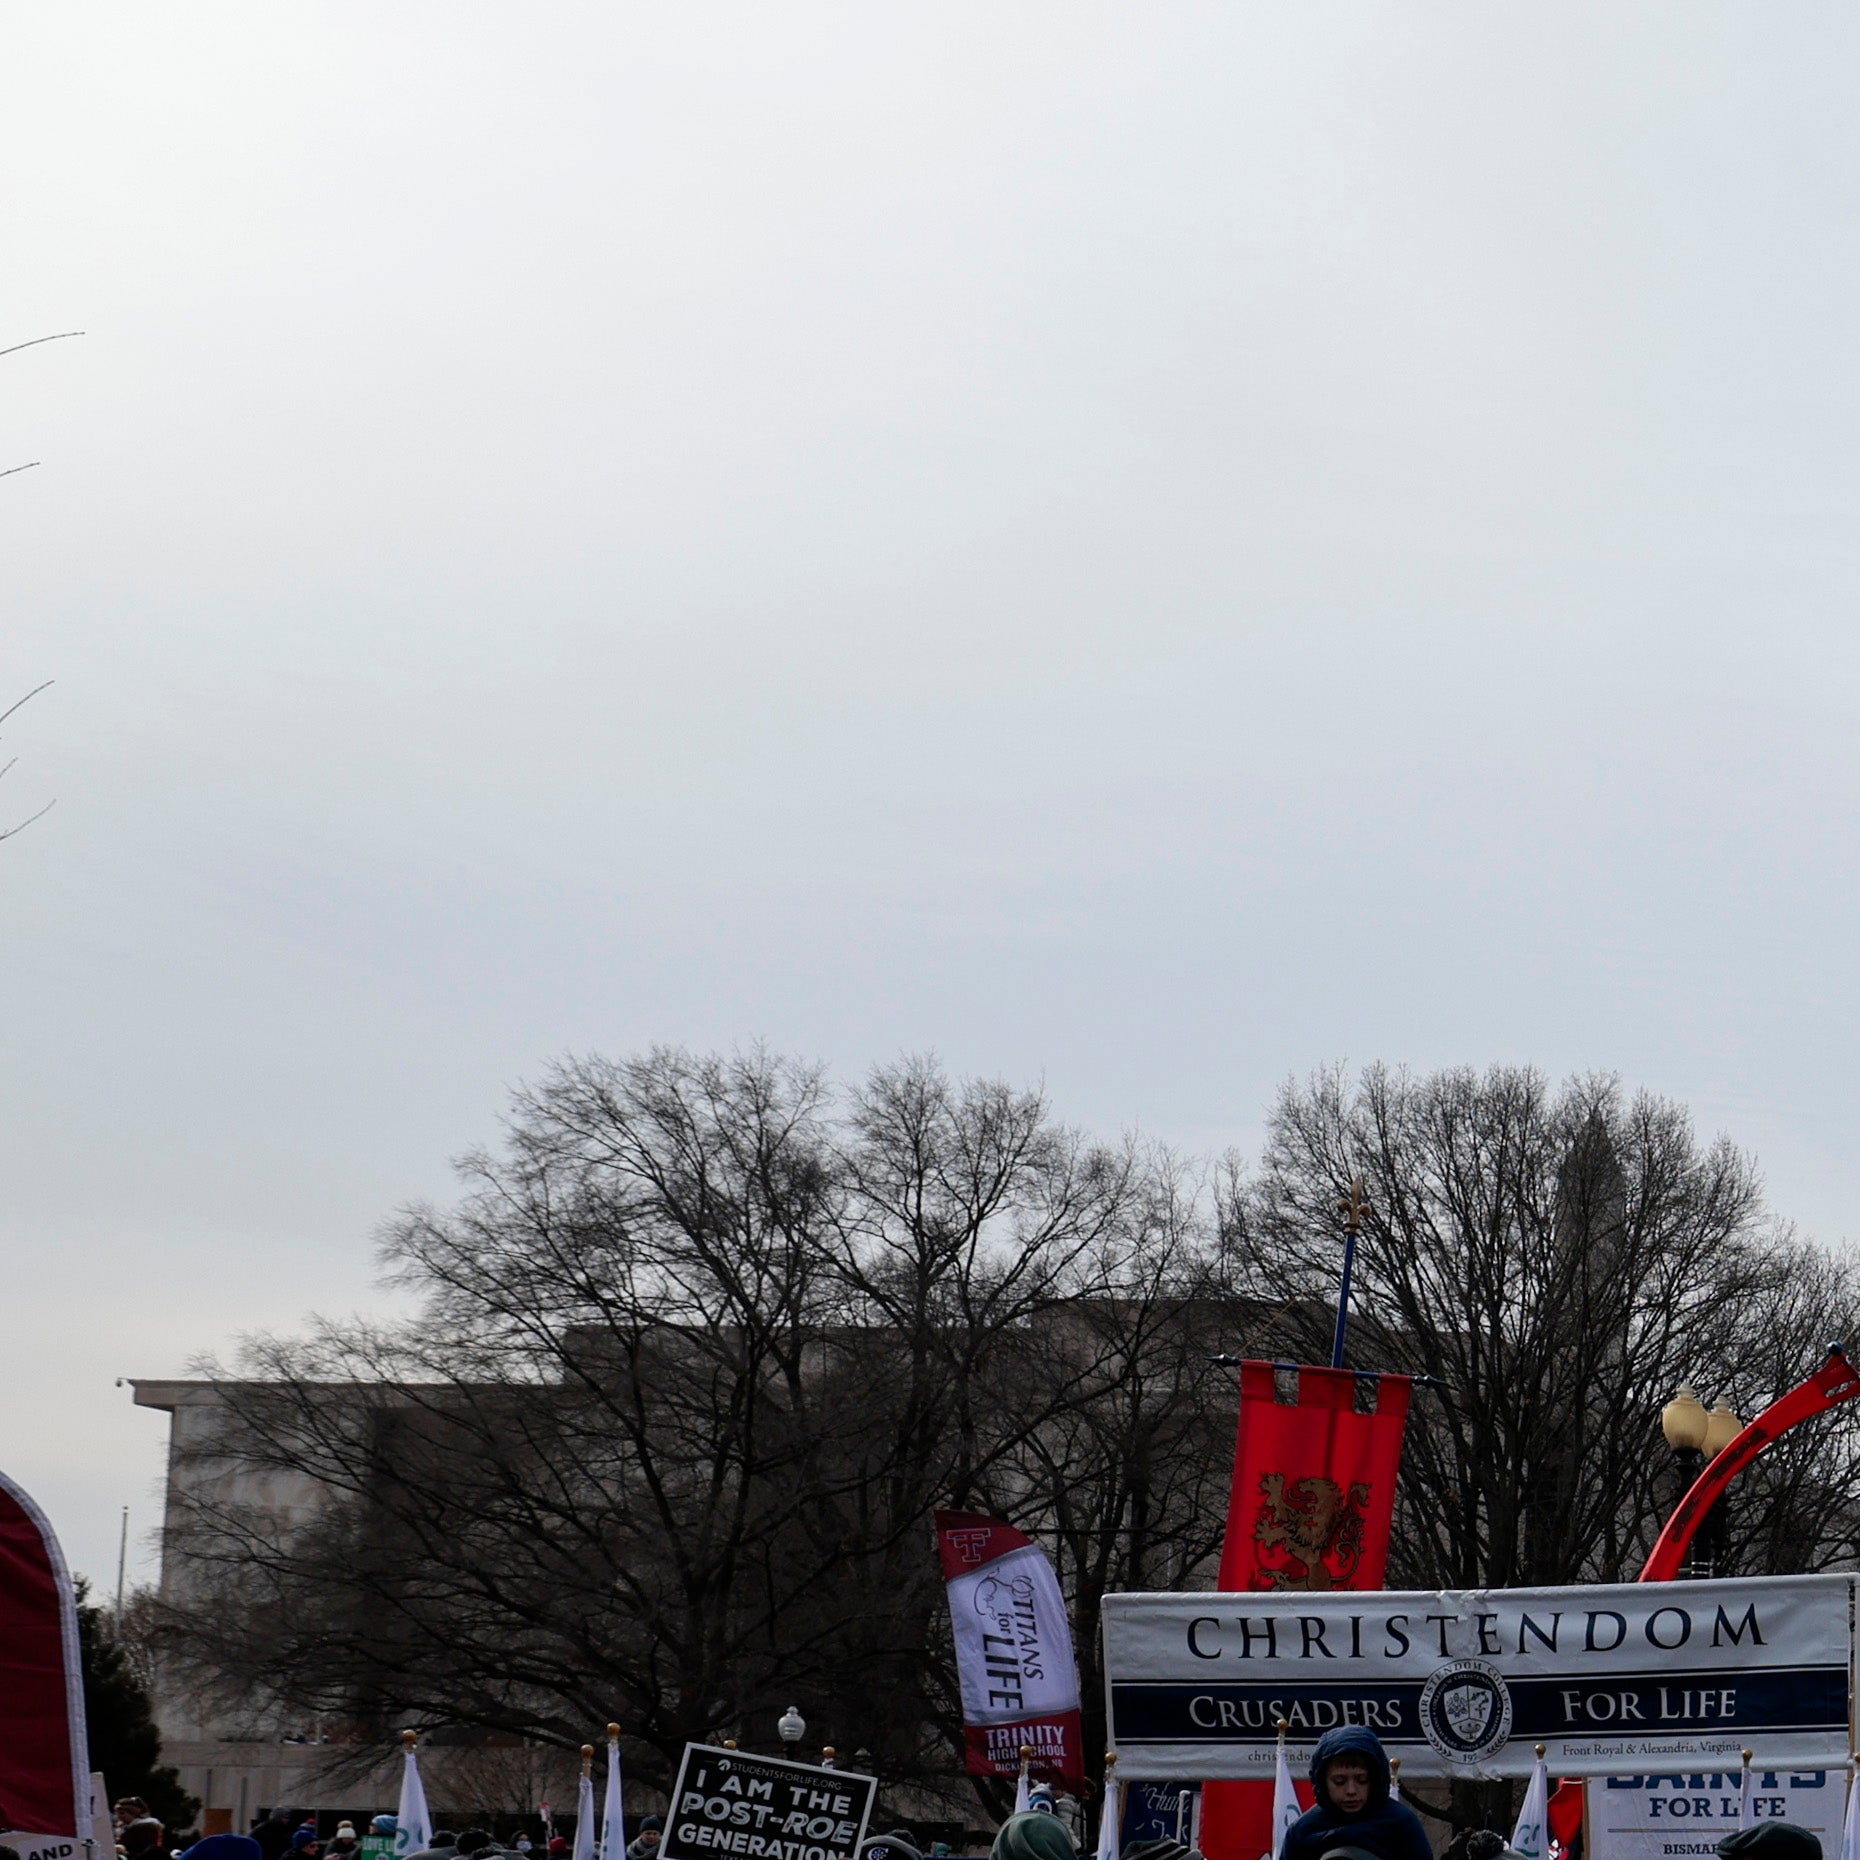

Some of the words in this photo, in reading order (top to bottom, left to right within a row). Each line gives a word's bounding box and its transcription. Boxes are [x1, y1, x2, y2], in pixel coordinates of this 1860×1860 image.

[998, 1612, 1015, 1633] for
[1187, 1603, 1768, 1659] CHRISTENDOM
[1013, 1599, 1044, 1681] TITANS
[982, 1633, 1023, 1710] LIFE
[984, 1725, 1065, 1749] TRINITY
[1563, 1744, 1591, 1756] Front
[1594, 1742, 1624, 1758] Royal
[1626, 1744, 1637, 1755] &
[1639, 1740, 1698, 1756] Alexandria,
[1700, 1739, 1742, 1756] Virginia
[987, 1747, 1018, 1761] HIGH
[1026, 1745, 1067, 1757] CHOOL
[731, 1762, 842, 1790] STUDENTSFORLIFE.ORG
[696, 1769, 707, 1788] I
[720, 1775, 774, 1800] AM
[789, 1786, 852, 1815] THE
[680, 1791, 858, 1845] POST-ROE
[1649, 1797, 1714, 1817] FOR
[1719, 1797, 1786, 1817] LFE
